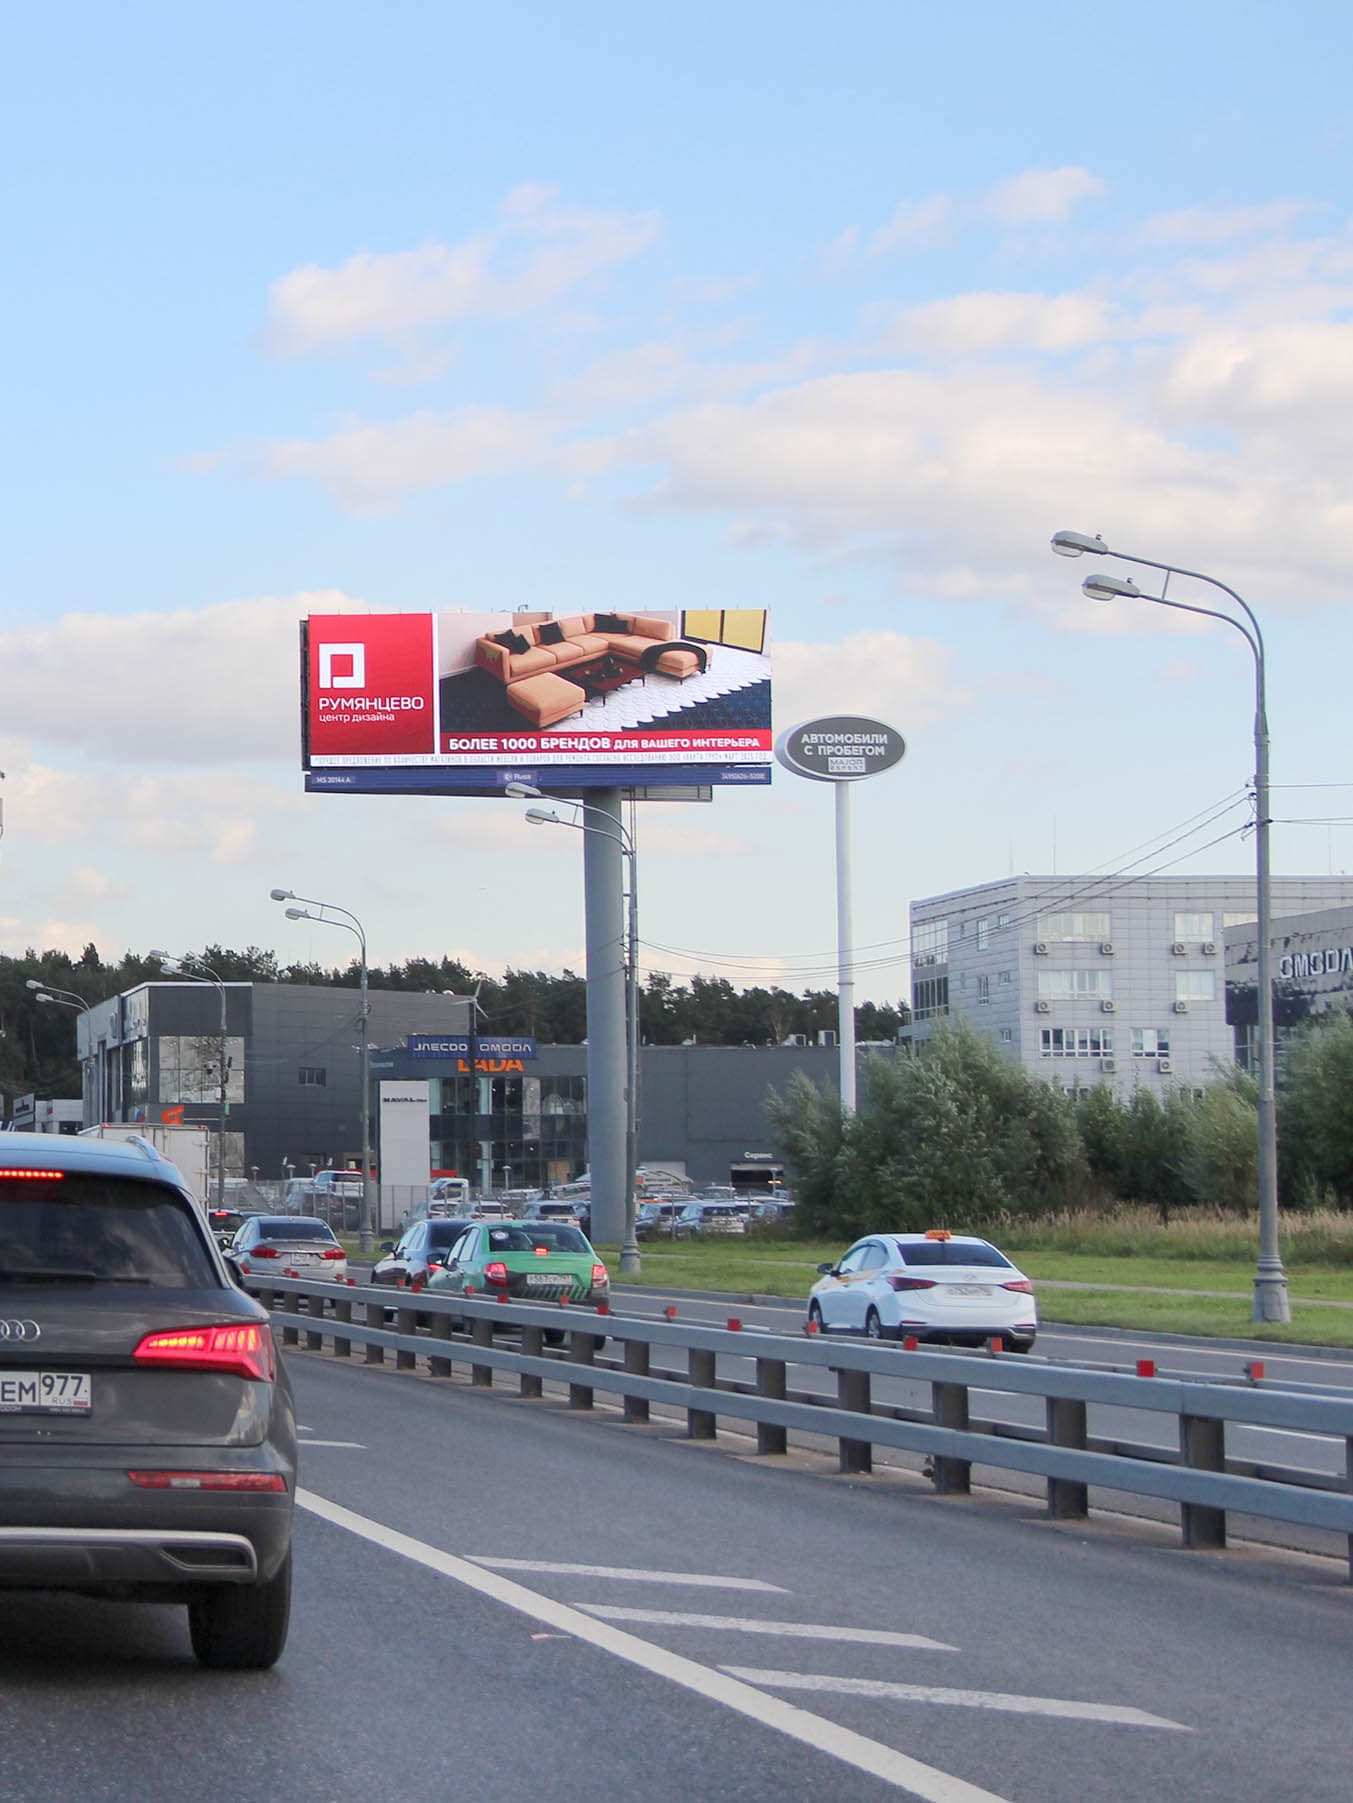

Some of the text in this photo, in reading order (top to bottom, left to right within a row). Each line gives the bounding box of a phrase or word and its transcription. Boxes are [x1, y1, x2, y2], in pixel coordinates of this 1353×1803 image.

[319, 697, 424, 711] РУМЯНЦЕВО
[319, 712, 395, 723] центр дизайна
[449, 738, 498, 750] БОЛЕЕ
[501, 738, 537, 750] 1000
[541, 737, 611, 751] БРЕНДОВ
[641, 738, 690, 748] ВАШЕГО
[693, 737, 761, 748] ИНТЕРЬЕРА
[801, 734, 888, 744] АВТОМОБИЛИ
[804, 745, 885, 755] С ПРОБЕГОМ
[414, 1043, 532, 1052] JAECOO OMODA
[457, 1059, 524, 1072] LADA
[41, 1375, 84, 1397] 977
